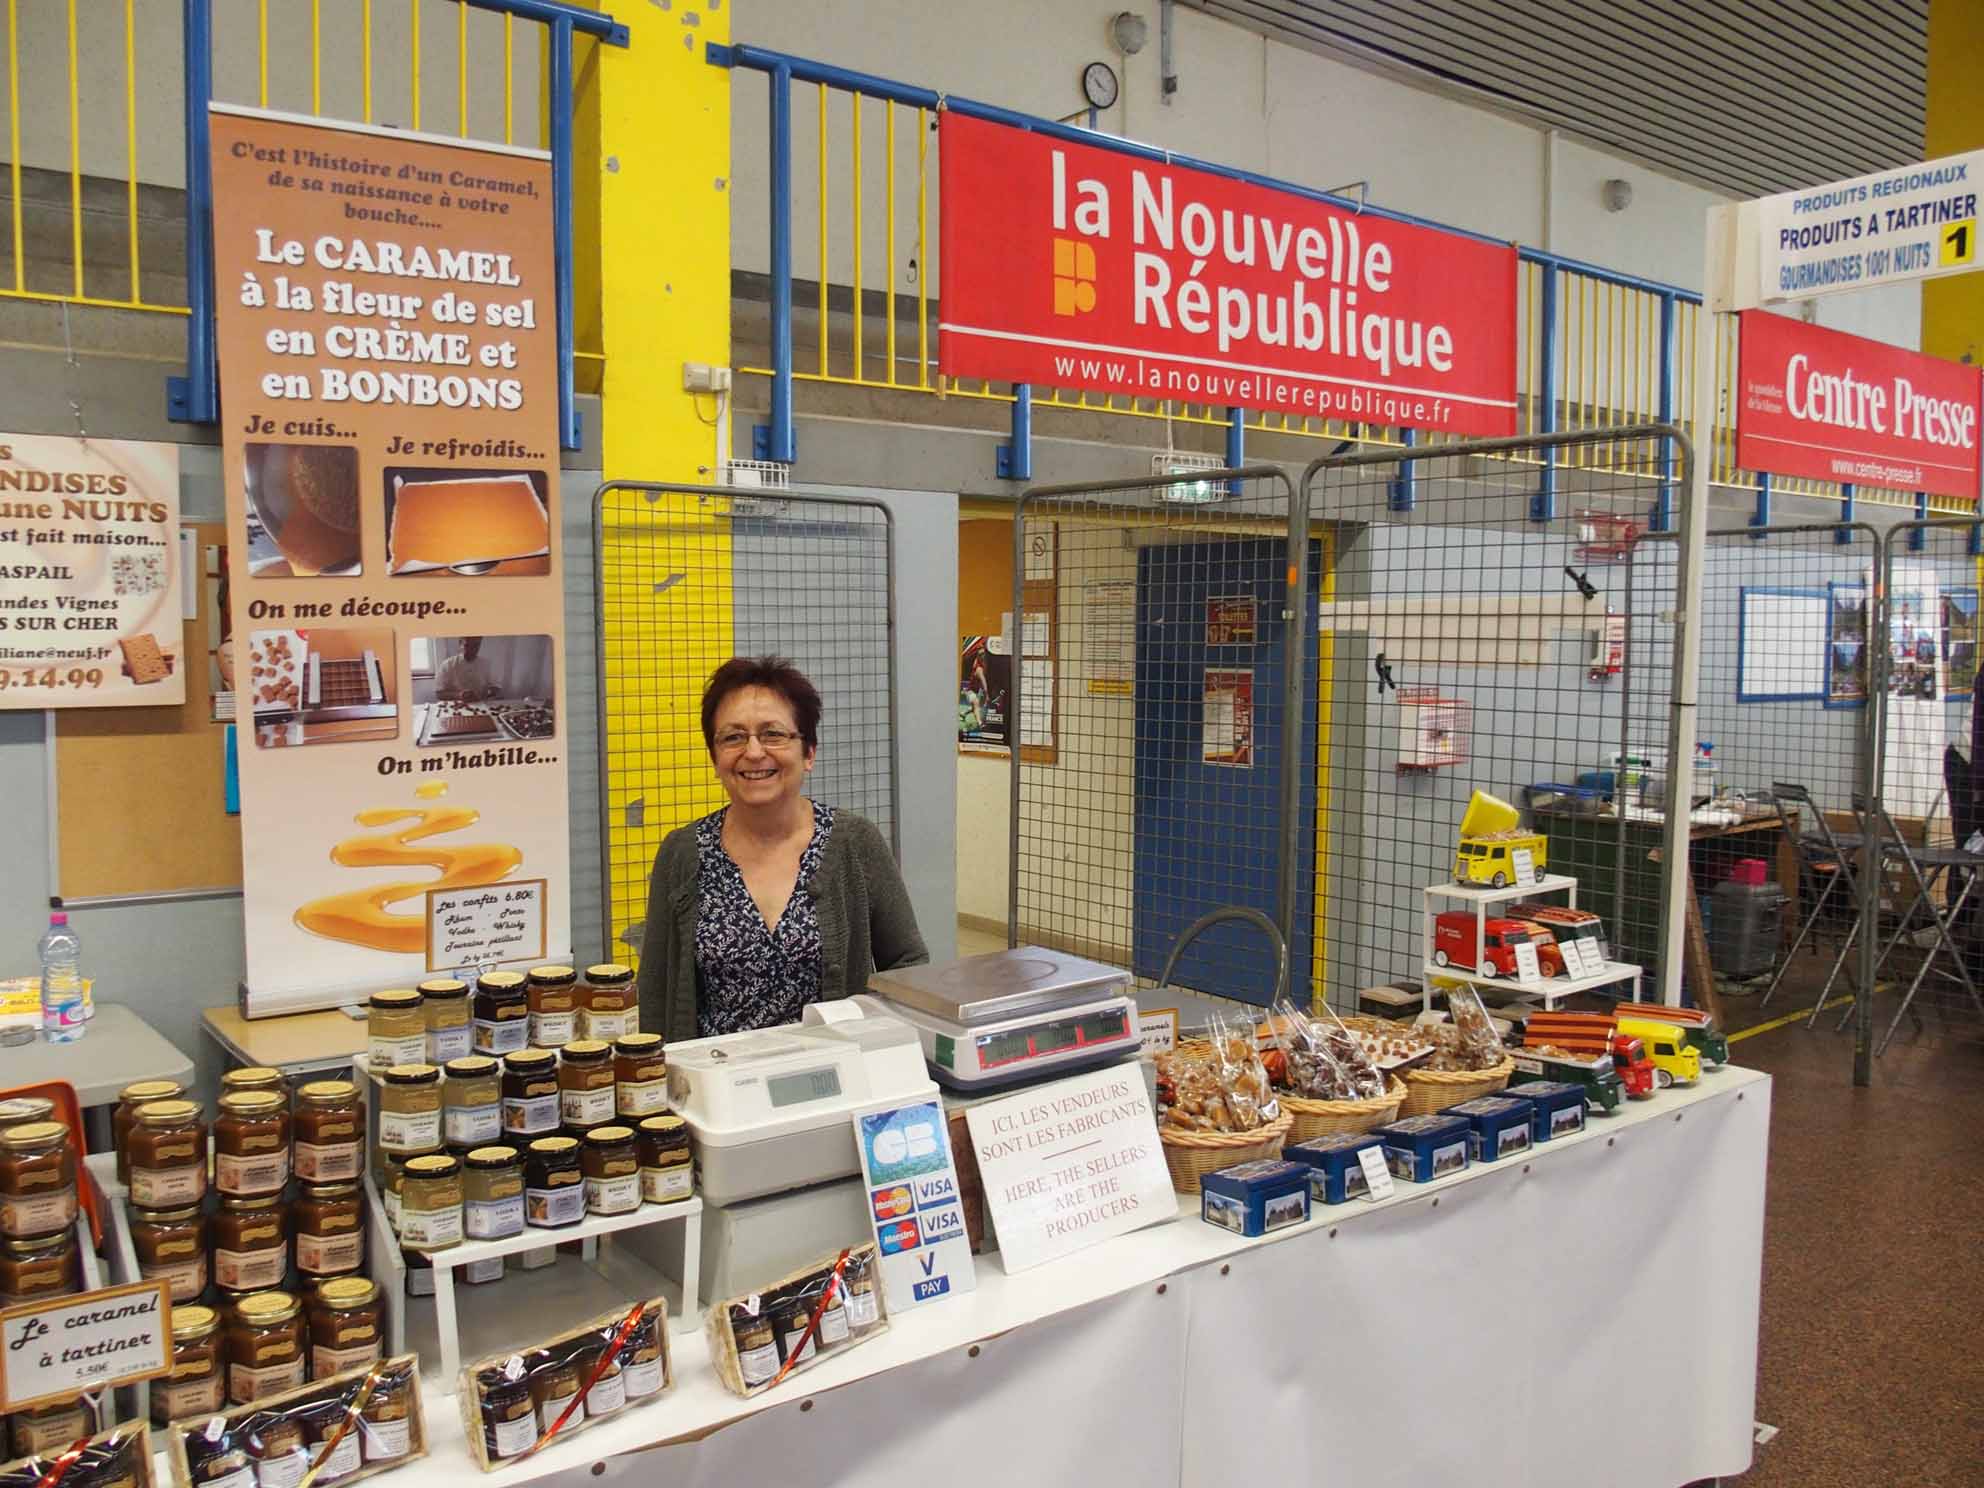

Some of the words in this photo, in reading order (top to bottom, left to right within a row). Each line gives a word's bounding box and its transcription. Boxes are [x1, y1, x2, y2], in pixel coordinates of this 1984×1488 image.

[231, 141, 286, 164] C'est
[293, 151, 391, 177] l'histoire
[398, 164, 443, 184] d'un
[450, 171, 539, 199] Caramel,
[1793, 185, 1867, 215] PRODUITS
[1872, 164, 1968, 198] REGIONAUX
[268, 171, 295, 188] de
[301, 176, 324, 192] sa
[331, 182, 432, 206] naissance
[439, 190, 451, 208] à
[457, 196, 510, 215] votre
[1051, 150, 1110, 238] la
[1132, 170, 1393, 293] Nouvelle
[1780, 216, 1862, 250] PRODUITS
[1867, 213, 1879, 237] A
[1884, 194, 1977, 232] TARTINER
[1946, 226, 1968, 258] 1
[256, 229, 305, 265] Le
[314, 236, 521, 287] CARAMEL
[1780, 254, 1862, 290] GOURMANDISES
[1865, 247, 1892, 278] 1001
[1893, 241, 1931, 272] NUITS
[240, 272, 265, 307] à
[273, 276, 314, 311] la
[322, 280, 423, 320] fleur
[432, 292, 477, 325] de
[485, 299, 536, 329] sel
[1133, 251, 1454, 376] République
[266, 327, 315, 356] en
[325, 320, 472, 366] CRÈME
[480, 341, 518, 368] et
[261, 372, 312, 400] en
[320, 368, 523, 410] BONBONS
[1054, 354, 1452, 425] www.lanouvellerepublique.fr
[1786, 354, 1887, 433] Centre
[1893, 376, 1976, 449] Presse
[245, 415, 274, 435] Je
[284, 417, 357, 438] cuis...
[387, 436, 414, 455] Je
[422, 438, 546, 460] refroidis...
[63, 500, 168, 523] NUITS
[27, 528, 65, 546] fait
[72, 530, 167, 547] maison...
[15, 617, 57, 631] SUR
[70, 617, 119, 631] CHER
[56, 597, 119, 611] Vignes
[249, 599, 285, 619] On
[293, 601, 333, 617] me
[341, 596, 467, 619] découpe...
[377, 755, 413, 776] On
[421, 746, 558, 772] m'habille...
[1020, 1105, 1049, 1127] LES
[1051, 1082, 1130, 1116] VENDEURS
[982, 1136, 1024, 1162] SONT
[1026, 1127, 1056, 1148] LES
[1057, 1101, 1147, 1139] FABRICANTS
[921, 1178, 953, 1198] VISA
[1055, 1167, 1084, 1188] THE
[1086, 1145, 1148, 1178] SELLERS
[1055, 1190, 1088, 1213] ARE
[1089, 1177, 1120, 1199] THE
[927, 1211, 959, 1232] VISA
[1046, 1195, 1139, 1239] PRODUCERS
[917, 1251, 934, 1276] V
[921, 1280, 942, 1296] PAY
[10, 1318, 49, 1350] Le
[64, 1294, 159, 1330] caramel
[39, 1353, 53, 1368] à
[62, 1333, 152, 1364] tartiner
